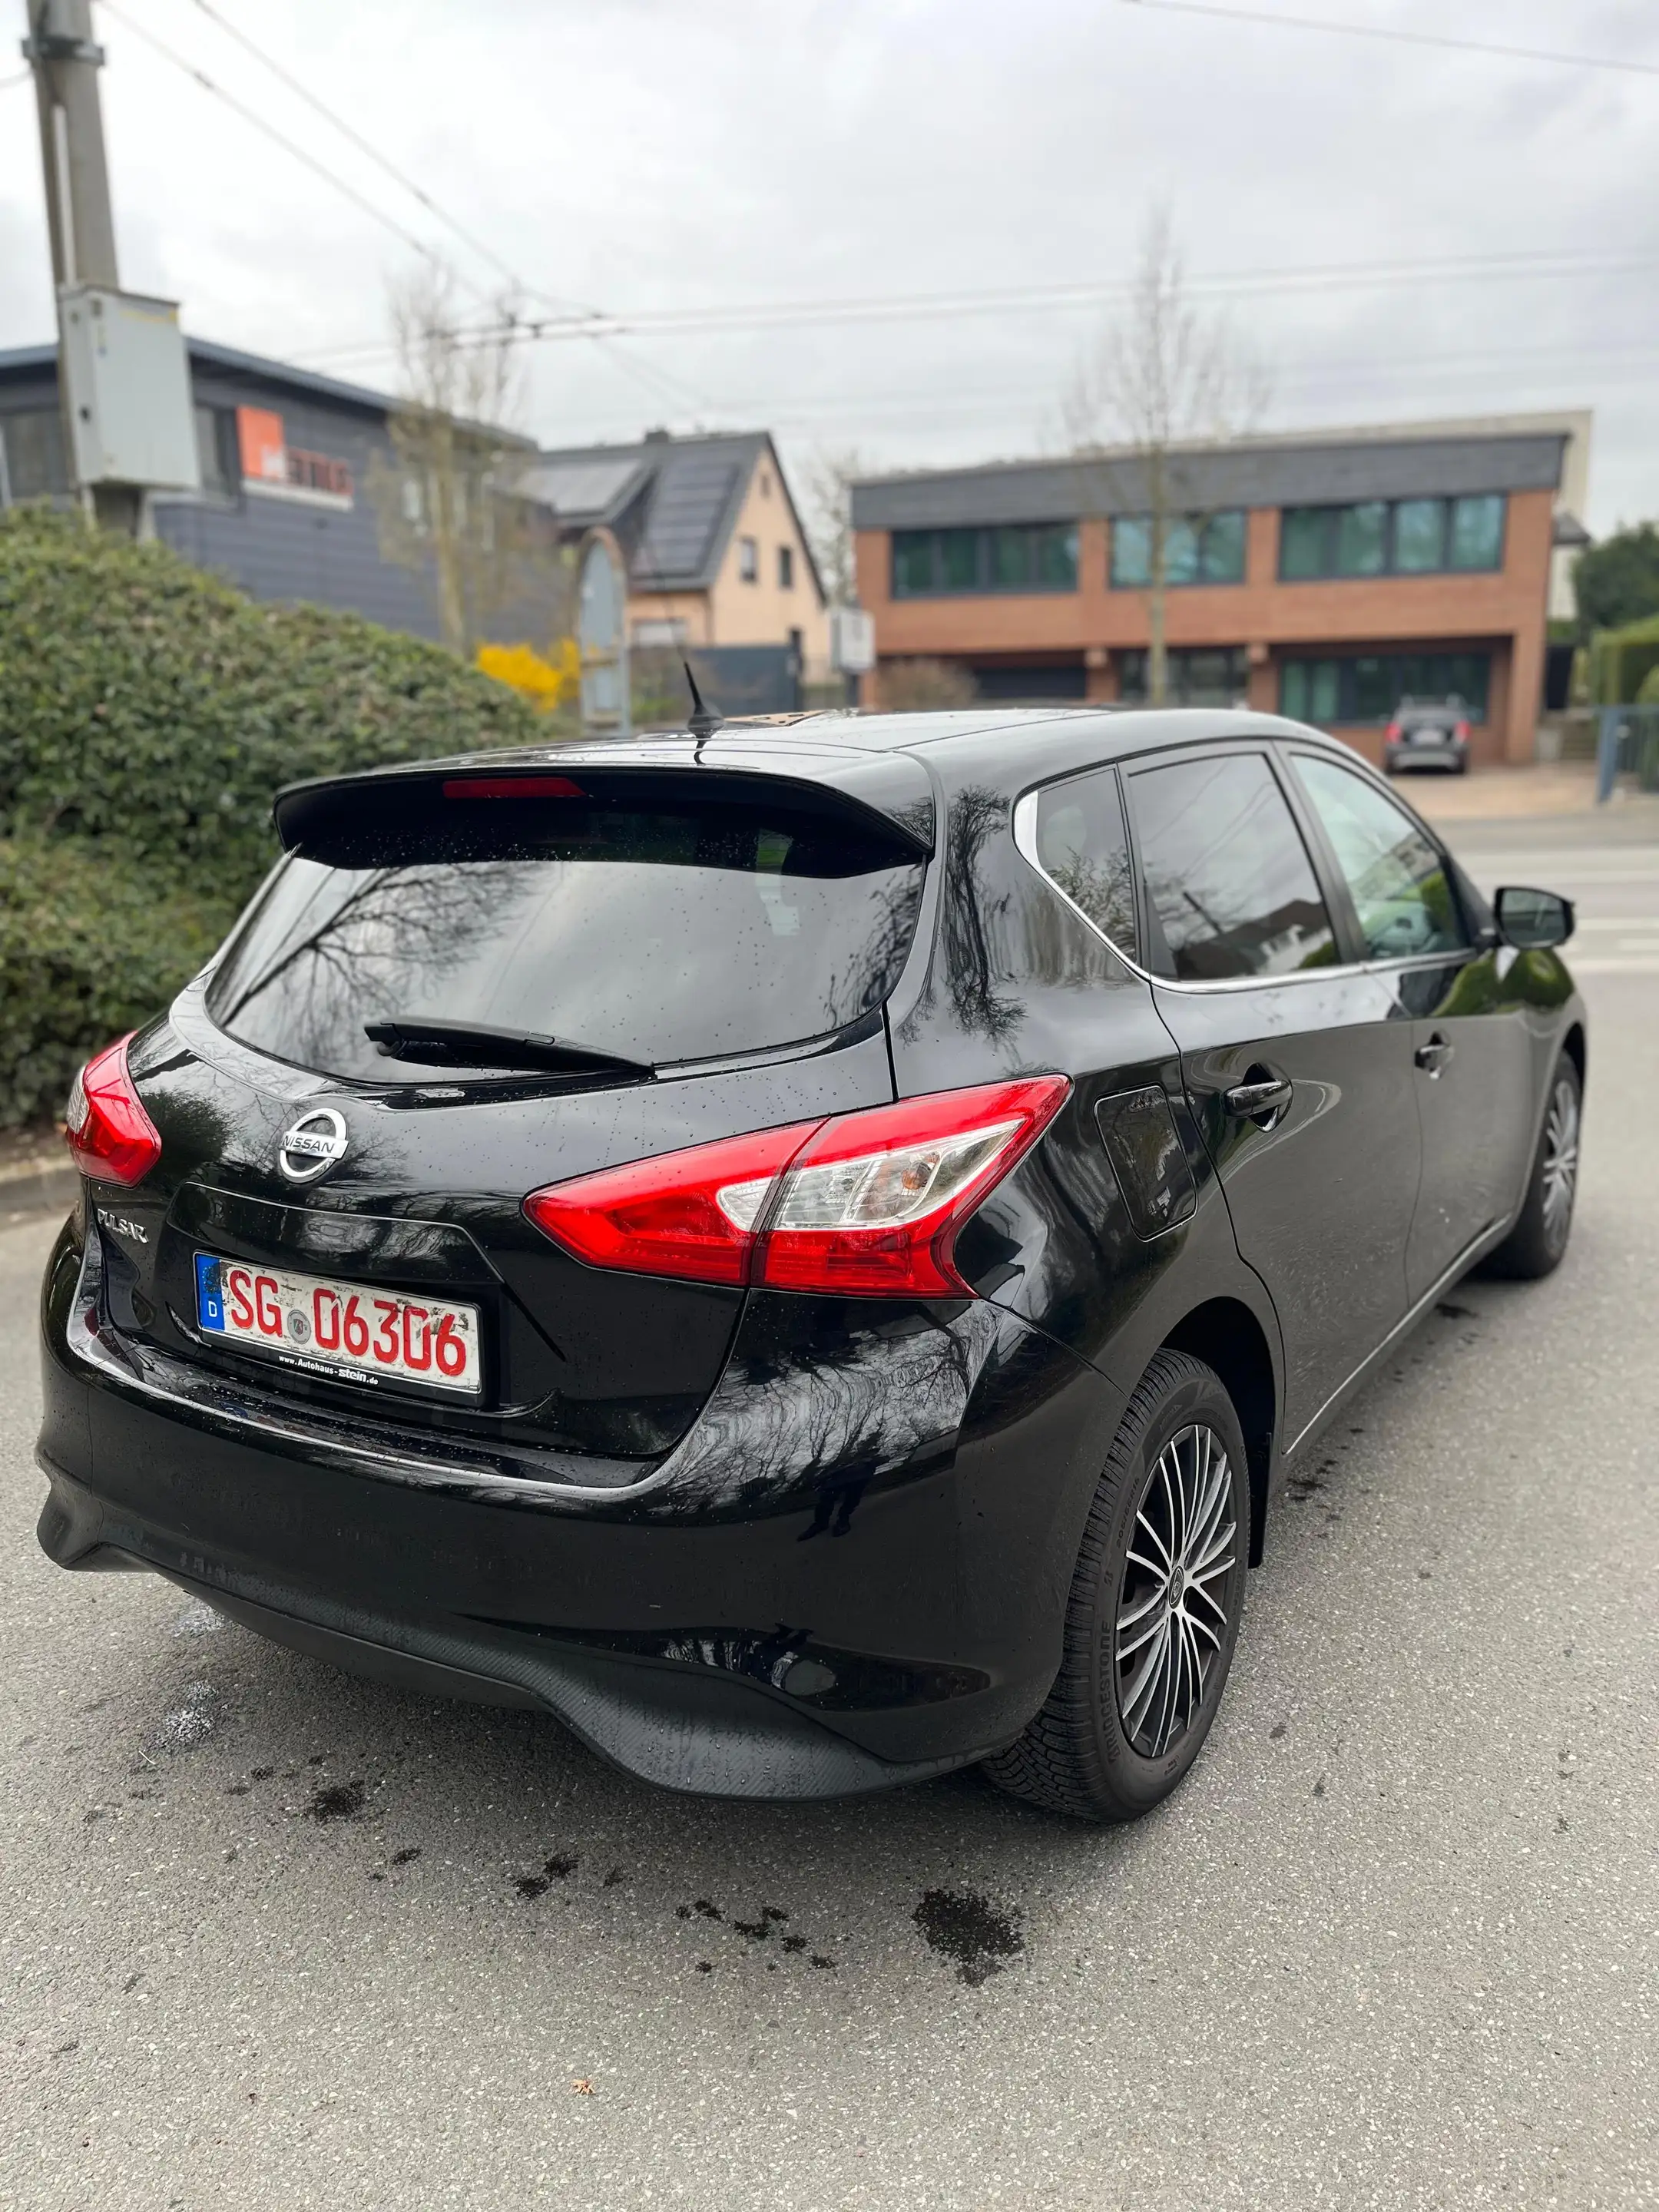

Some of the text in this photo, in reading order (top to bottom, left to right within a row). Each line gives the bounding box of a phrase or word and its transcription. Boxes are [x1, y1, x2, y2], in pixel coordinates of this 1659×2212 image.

[282, 1134, 335, 1154] NISSAN
[208, 1300, 217, 1318] D
[230, 1269, 467, 1376] SG 06306
[279, 1355, 379, 1386] www.Autohaus-stein.de
